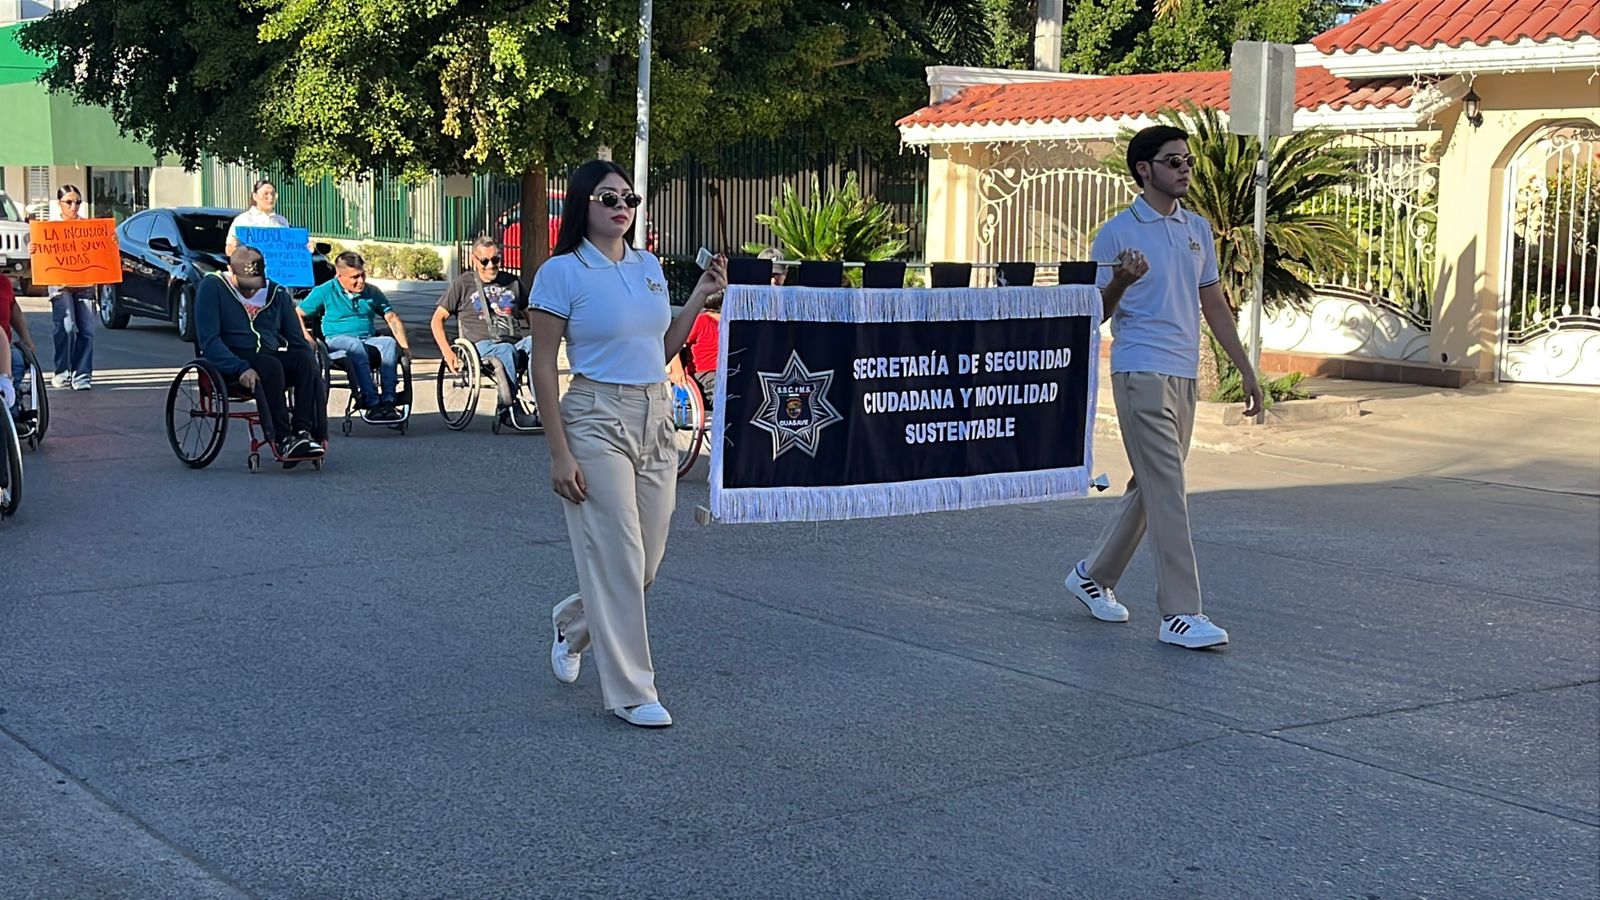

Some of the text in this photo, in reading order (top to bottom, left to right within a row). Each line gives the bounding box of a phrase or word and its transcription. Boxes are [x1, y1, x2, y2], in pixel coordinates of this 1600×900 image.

[44, 228, 59, 240] LA
[246, 227, 281, 243] ALCOHOL
[82, 241, 106, 251] SALVA
[56, 253, 90, 266] VIDAS
[853, 348, 1071, 380] SECRETARÍA DE SEGURIDAD
[863, 382, 1058, 414] CIUDADANA Y MOVILIDAD
[905, 417, 1015, 444] SUSTENTABLE
